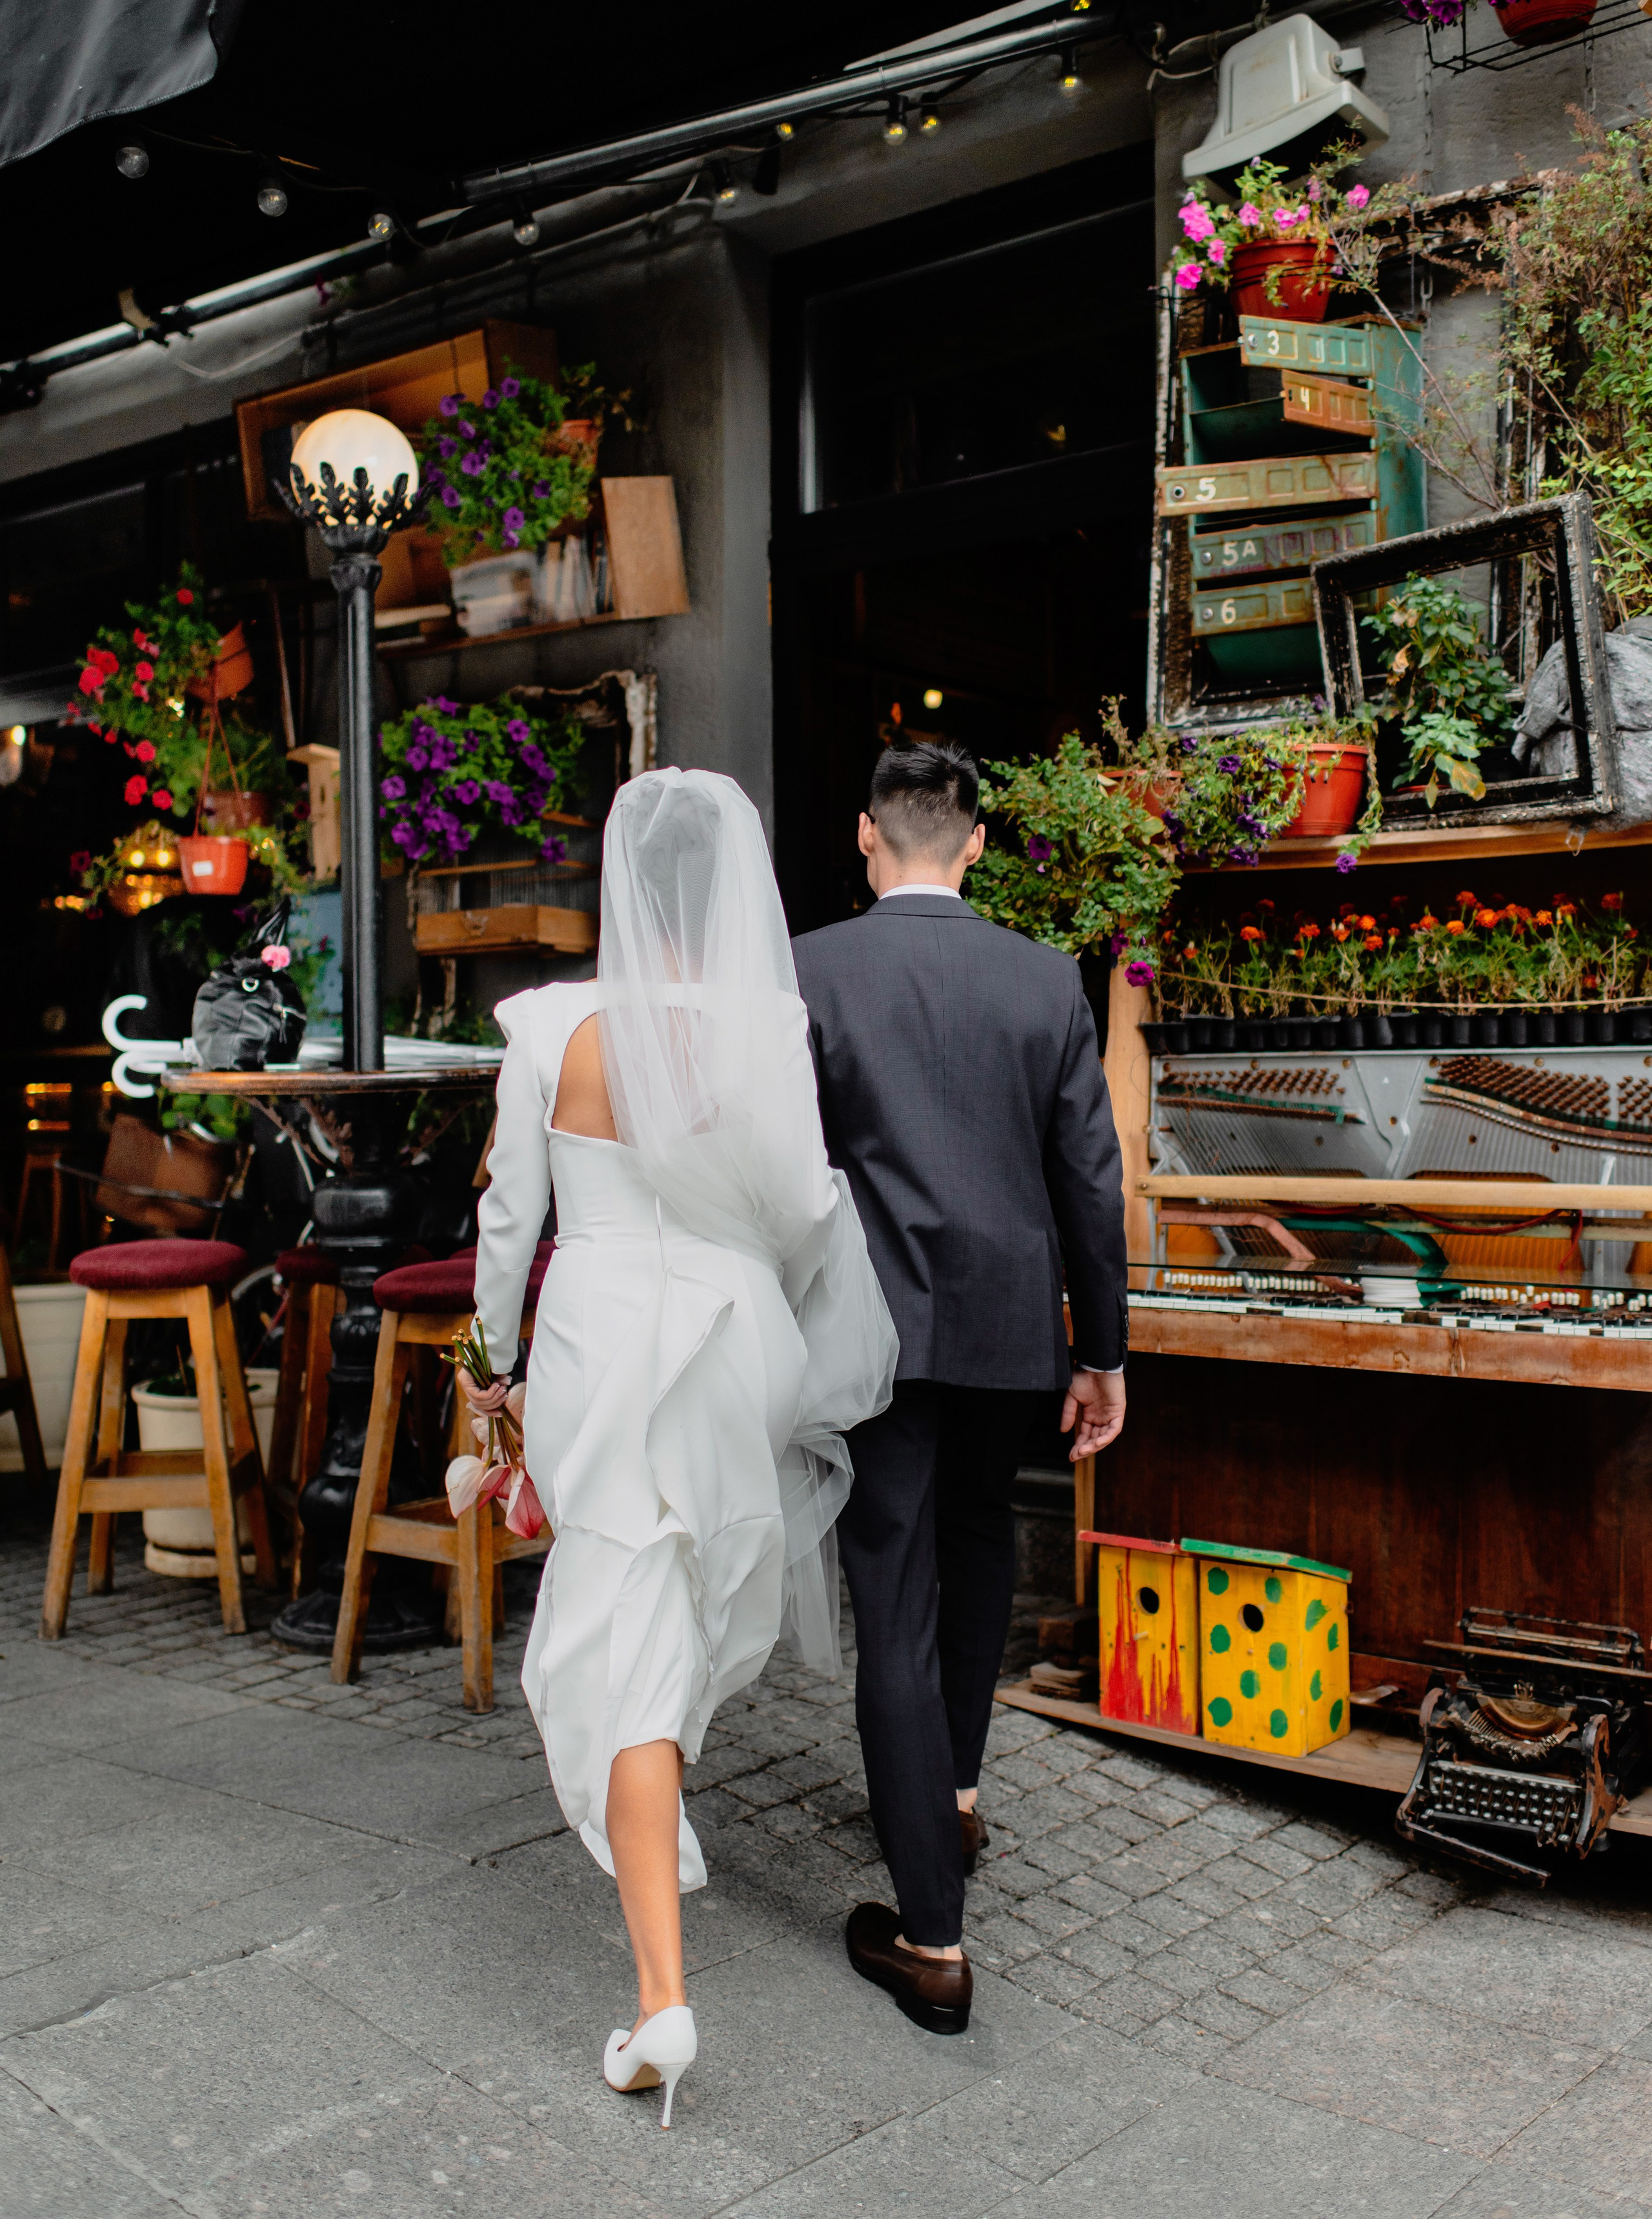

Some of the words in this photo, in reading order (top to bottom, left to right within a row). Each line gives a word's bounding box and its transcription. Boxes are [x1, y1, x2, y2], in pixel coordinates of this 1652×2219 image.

[1267, 330, 1280, 356] 3
[1300, 387, 1310, 412] 4
[1195, 477, 1216, 501] 5
[1222, 539, 1257, 567] 5A
[1221, 597, 1237, 625] 6
